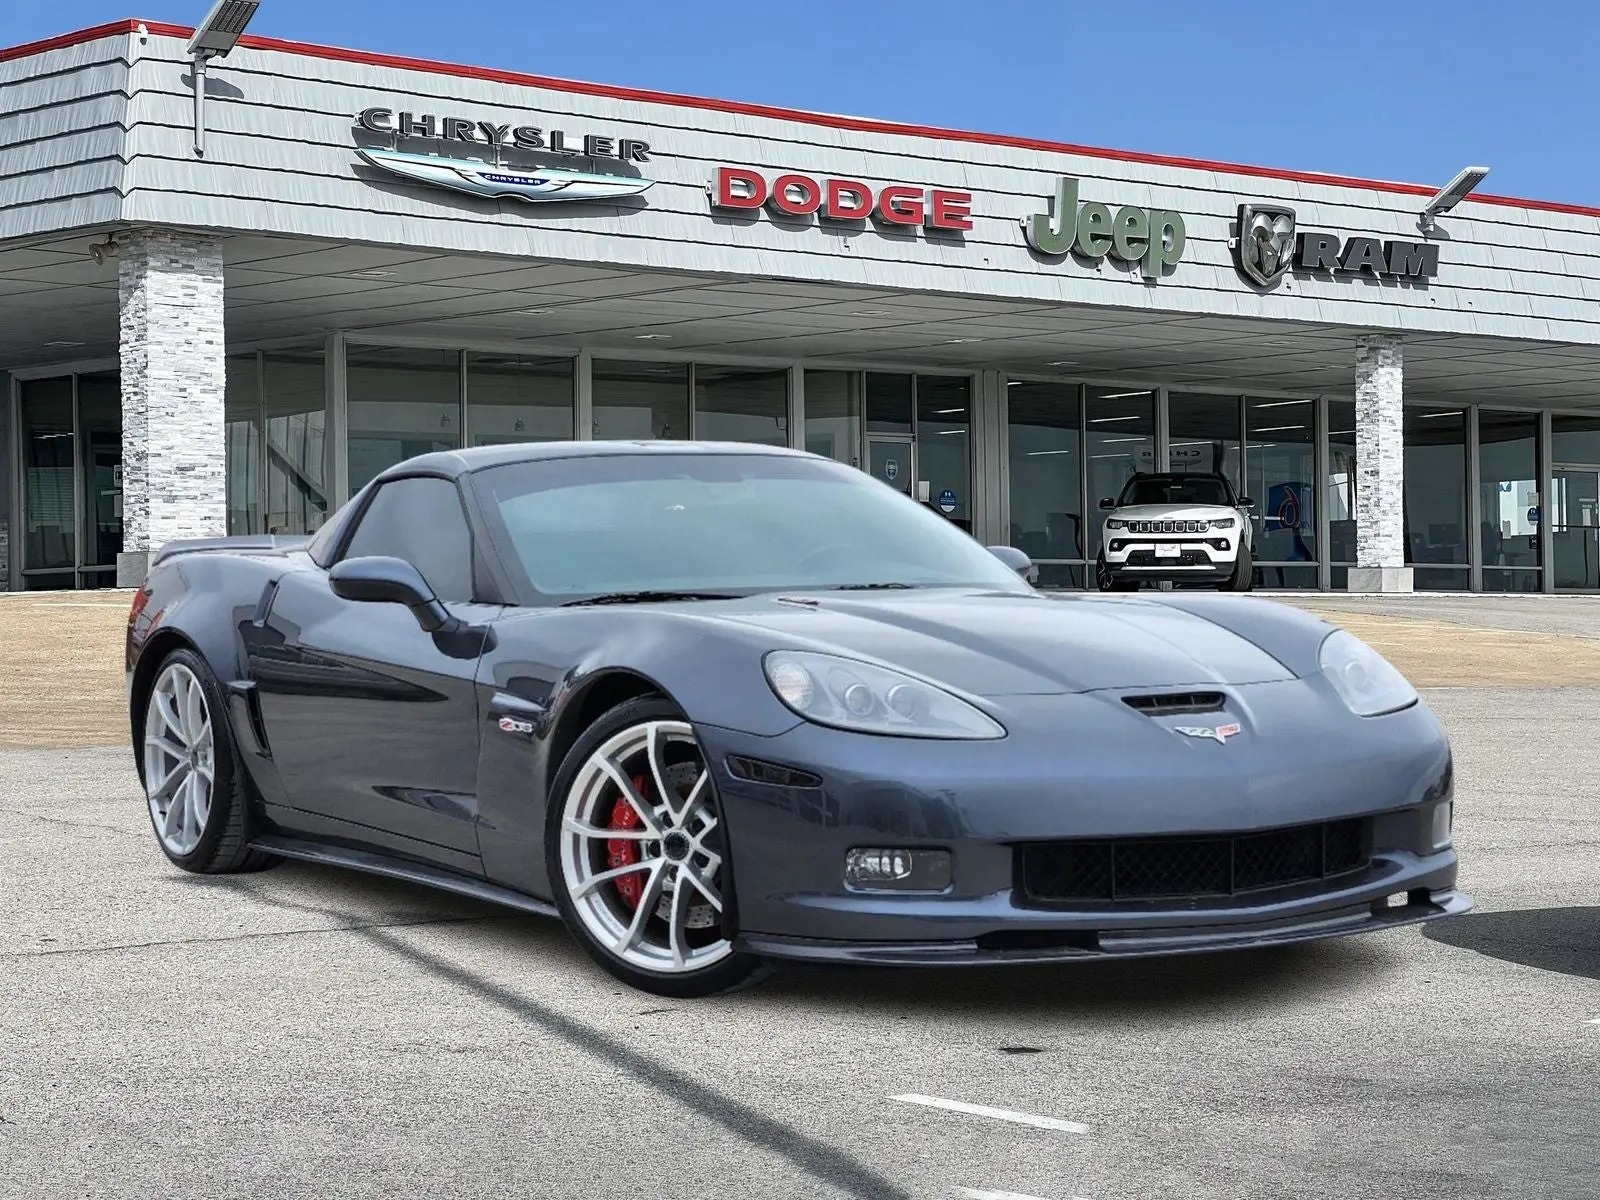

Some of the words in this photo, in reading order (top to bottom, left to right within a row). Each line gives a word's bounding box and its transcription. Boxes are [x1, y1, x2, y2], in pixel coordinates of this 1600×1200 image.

[359, 107, 651, 162] CHRYSLER
[484, 174, 541, 184] CHRYSLER
[711, 166, 974, 230] DODGE
[1025, 177, 1187, 279] Jeep
[1297, 231, 1439, 279] RAM
